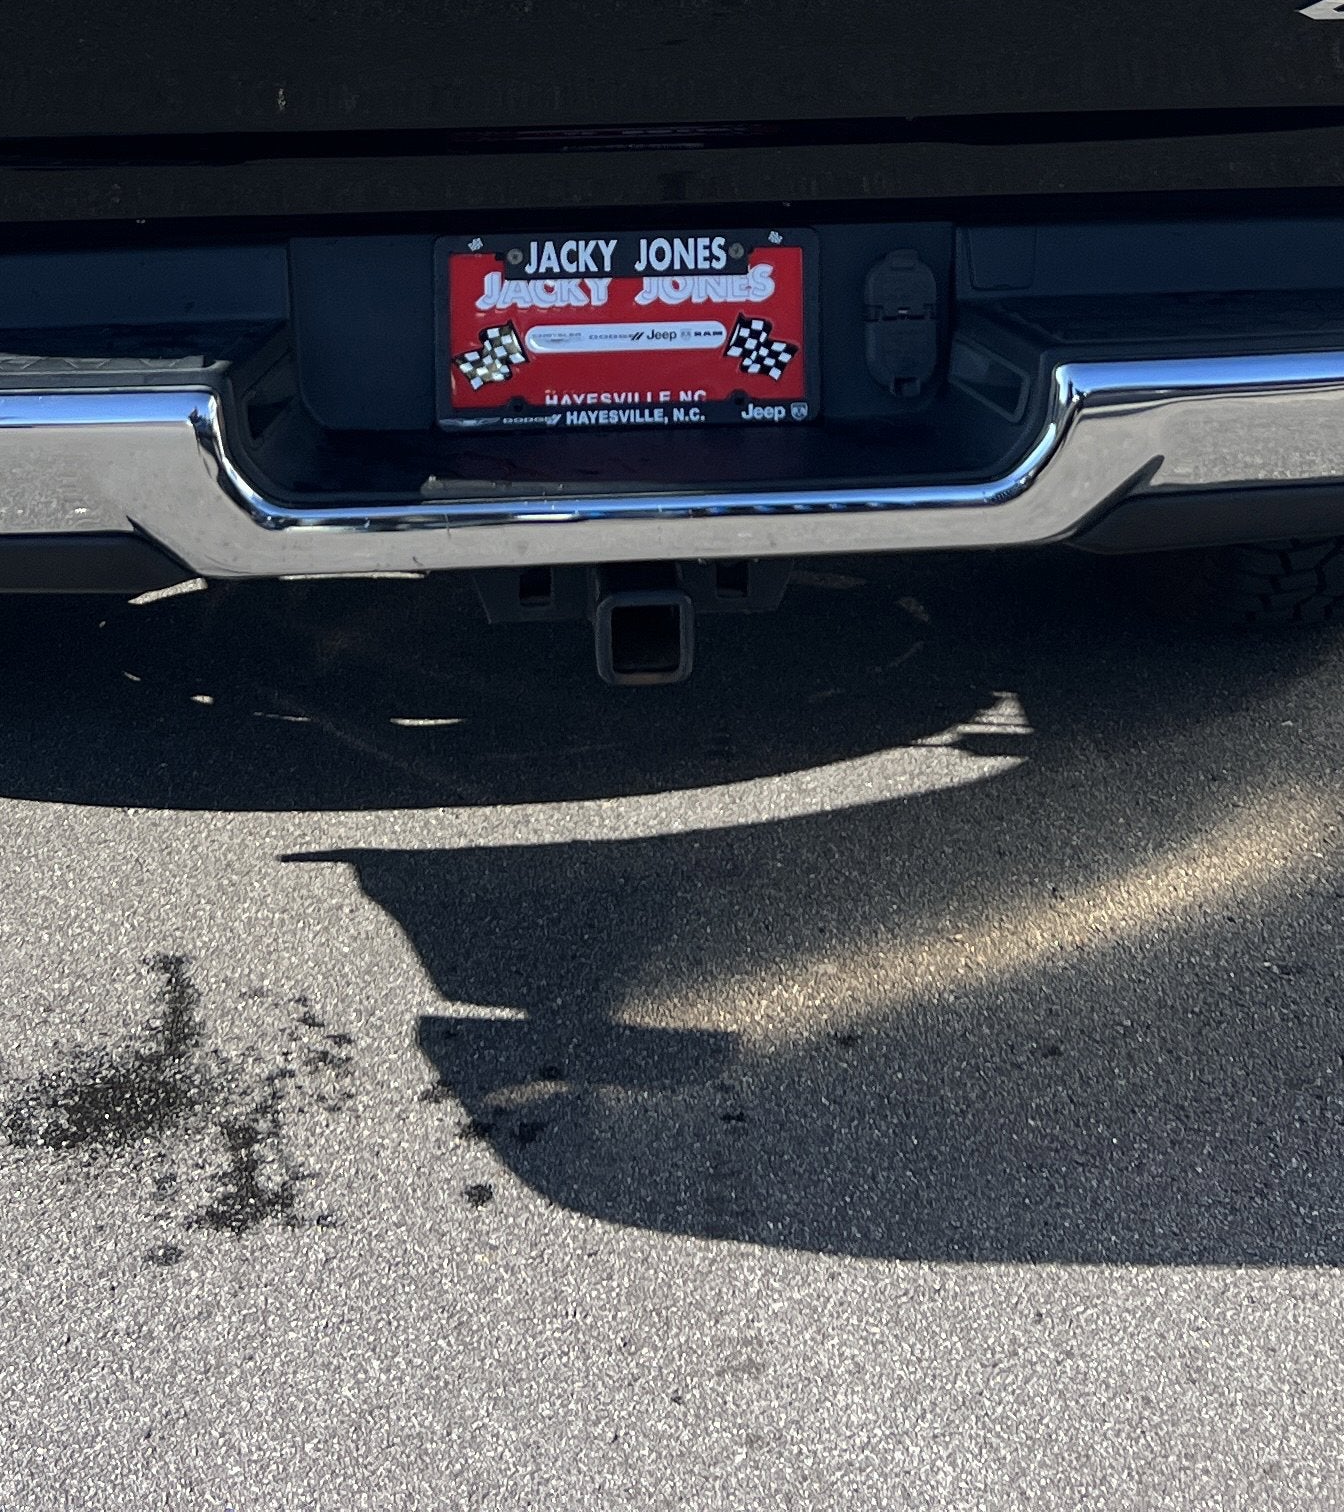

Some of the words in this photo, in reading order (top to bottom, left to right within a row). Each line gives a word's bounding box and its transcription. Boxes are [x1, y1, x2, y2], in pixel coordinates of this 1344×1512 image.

[524, 239, 617, 274] JACKY
[634, 237, 728, 271] JONES
[476, 272, 612, 311] JACKY
[634, 264, 776, 305] JONES
[646, 329, 677, 342] Jeep
[566, 408, 669, 425] HAYESVILLE,
[673, 407, 706, 423] N.C.
[741, 403, 786, 420] Jeep
